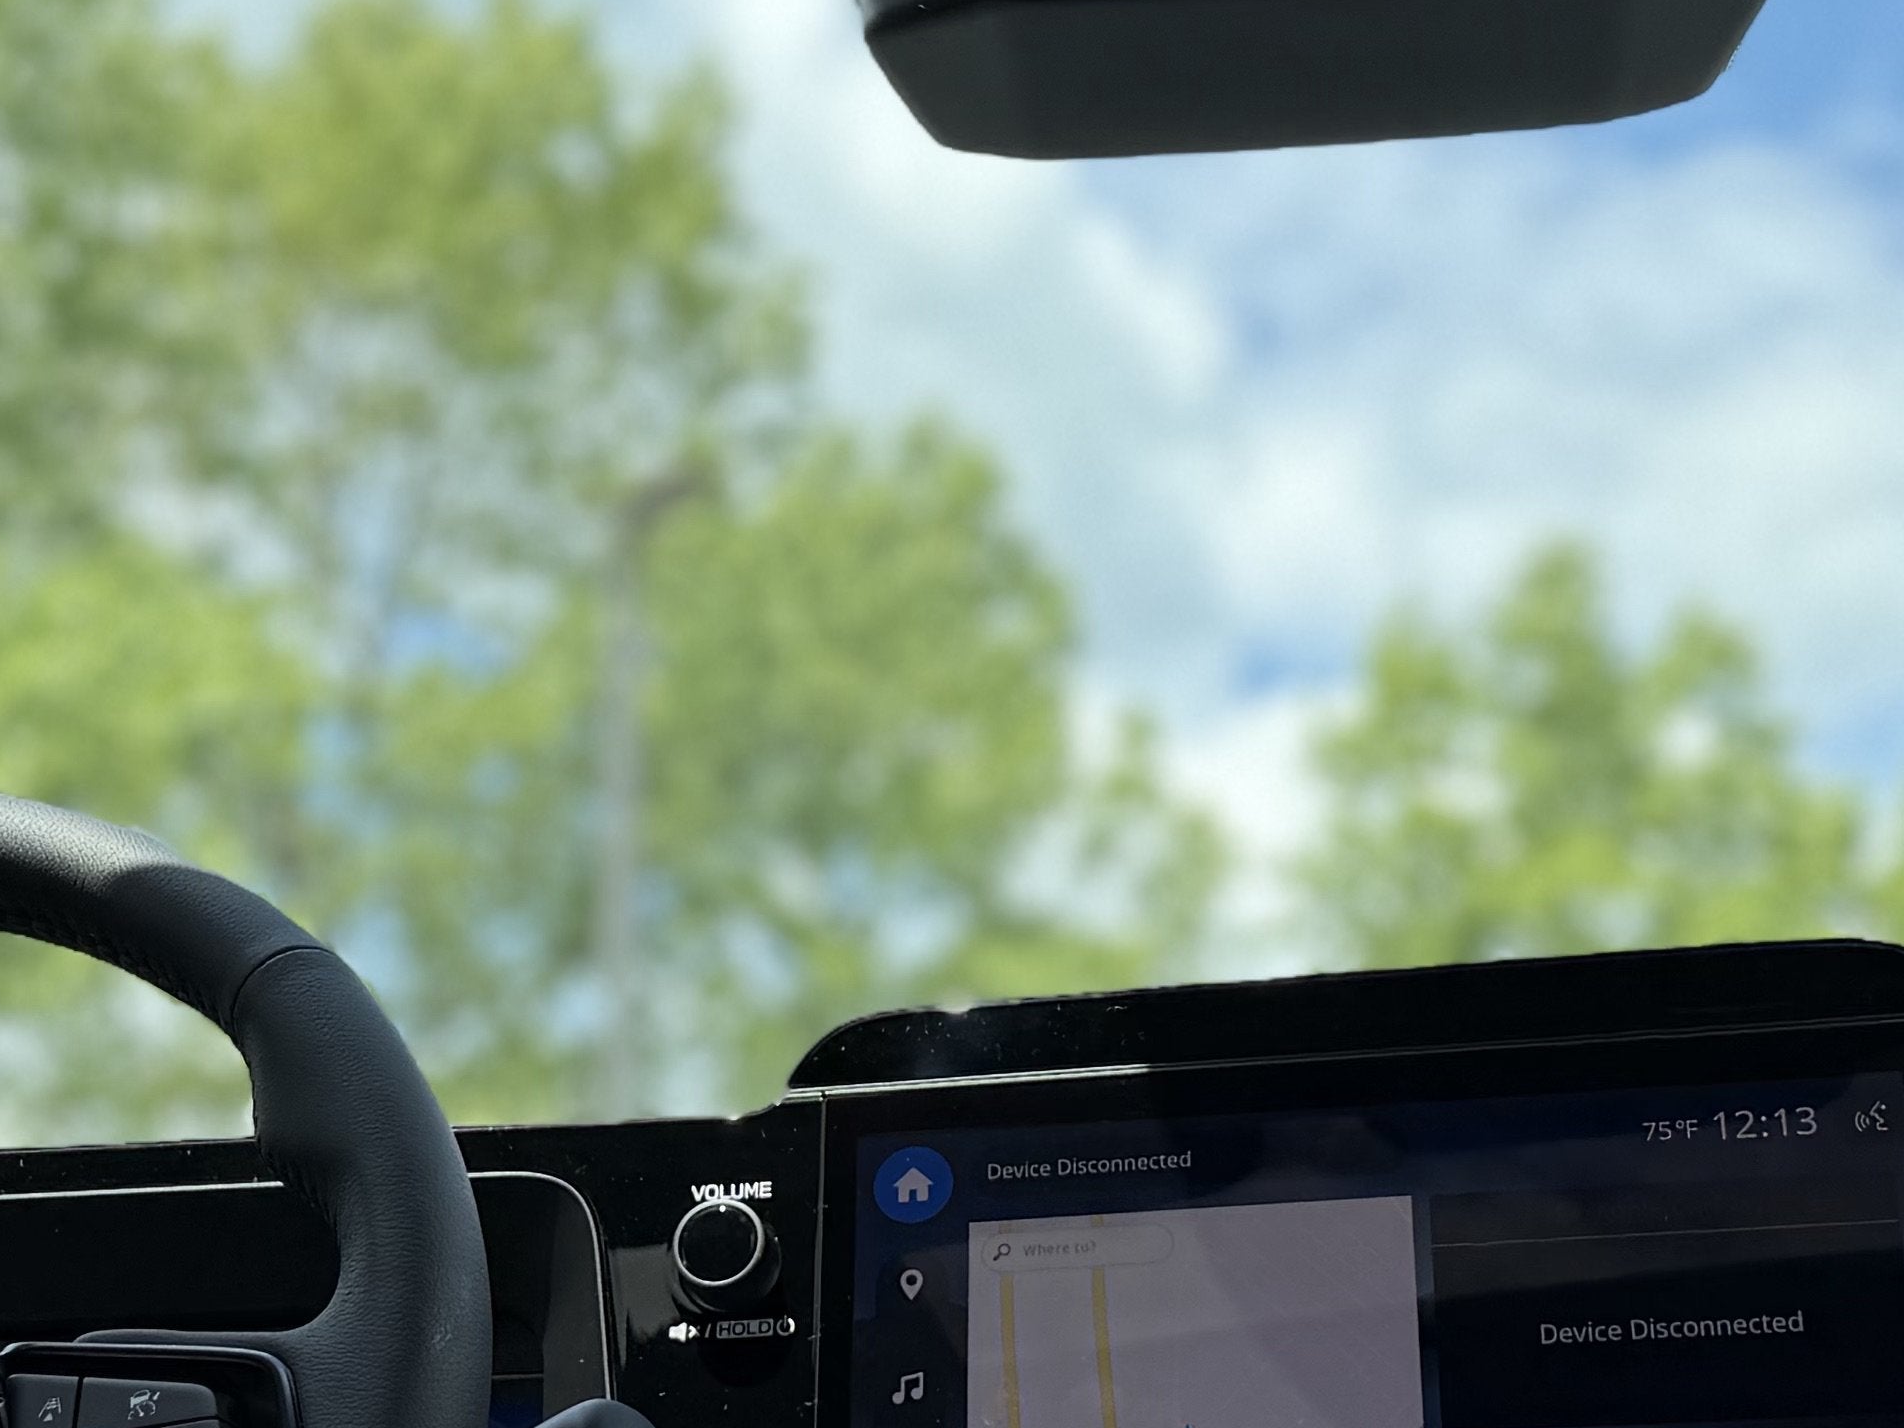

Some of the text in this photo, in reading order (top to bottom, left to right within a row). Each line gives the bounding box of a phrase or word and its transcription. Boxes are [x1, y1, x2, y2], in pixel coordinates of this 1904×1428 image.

[1640, 1105, 1819, 1144] 75°F 12:13
[986, 1149, 1193, 1182] Device Disconnected
[690, 1180, 773, 1203] VOLUME
[1022, 1243, 1070, 1257] Where
[717, 1320, 772, 1337] HOLD
[1539, 1309, 1806, 1346] Device Disconnected
